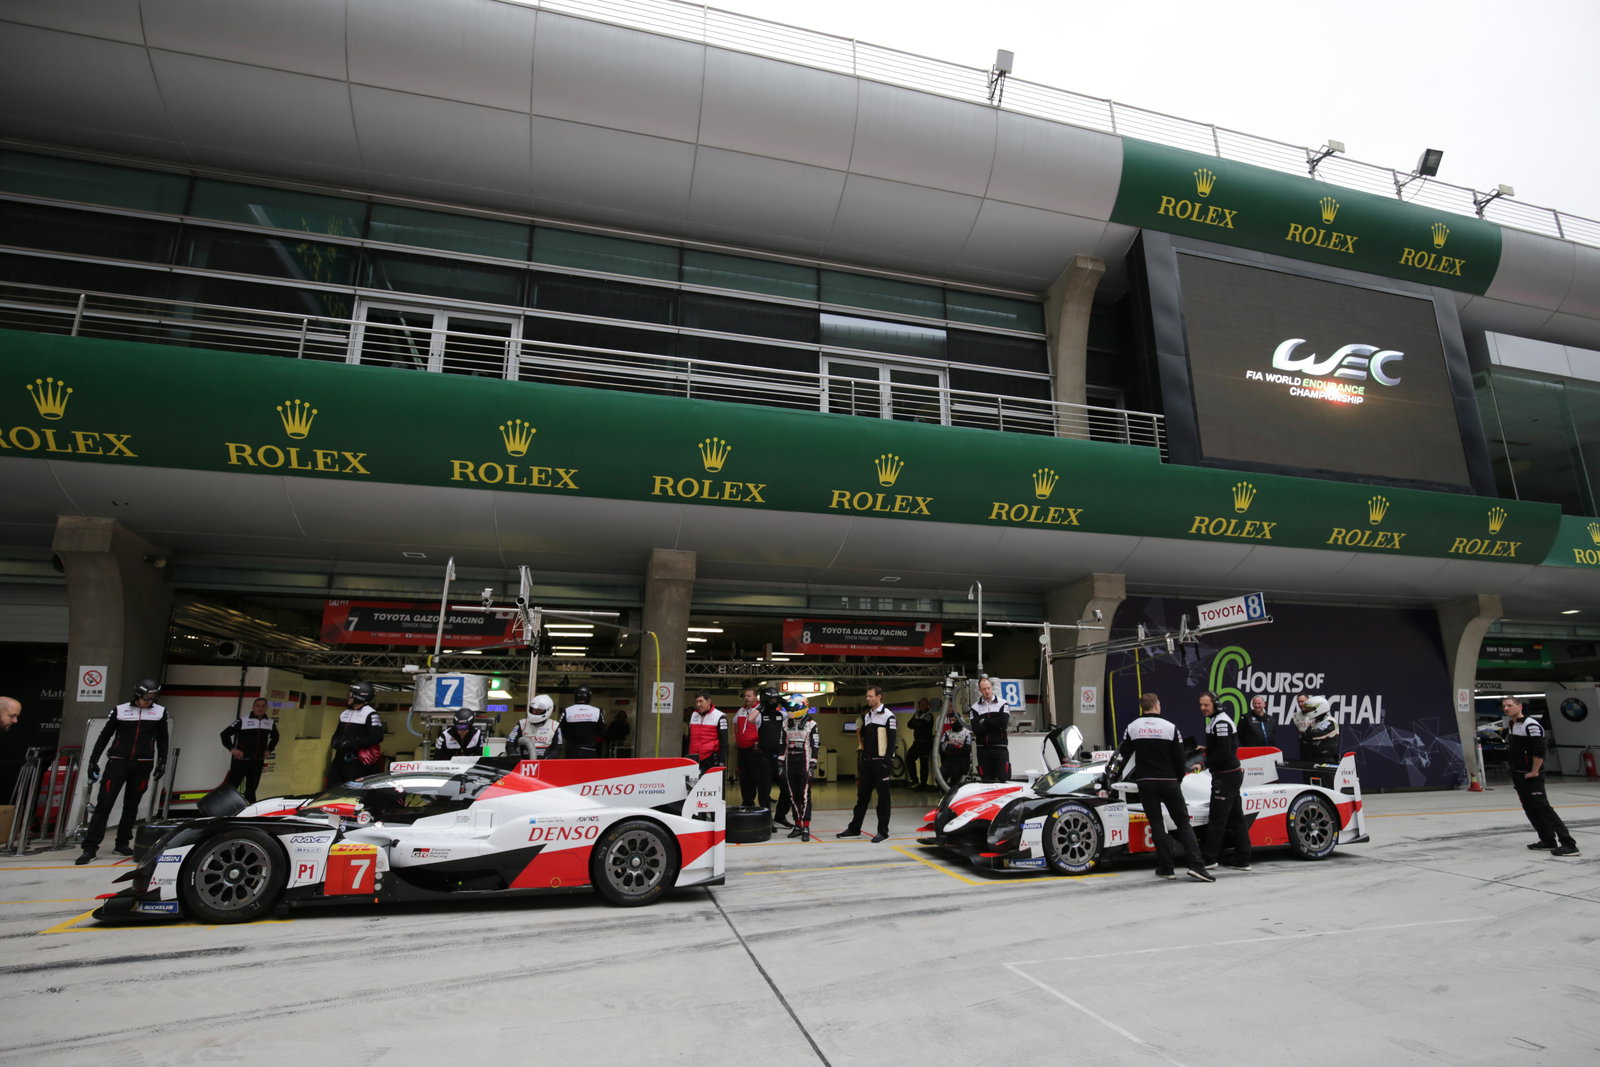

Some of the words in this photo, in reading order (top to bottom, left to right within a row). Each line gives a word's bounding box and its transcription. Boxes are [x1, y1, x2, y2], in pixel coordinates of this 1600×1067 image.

[1157, 195, 1238, 229] ROLEX
[1285, 223, 1359, 254] ROLEX
[1399, 248, 1466, 277] ROLEX
[1246, 370, 1264, 381] FIA
[1265, 372, 1301, 386] WORLD
[1302, 378, 1365, 395] ENDURANCE
[1289, 386, 1364, 405] CHAMPIONSHIP
[225, 442, 371, 475] ROLEX
[450, 460, 580, 490] ROLEX
[651, 475, 767, 503] ROLEX
[828, 490, 934, 515] ROLEX
[988, 502, 1083, 526] ROLEX
[1188, 516, 1277, 540] ROLEX
[1326, 527, 1407, 549] ROLEX
[1448, 537, 1522, 557] ROLEX
[373, 613, 410, 621] TOYOTA
[449, 616, 485, 624] RACING
[1201, 604, 1245, 621] TOYOTA
[1247, 595, 1261, 618] 8
[348, 617, 358, 632] 7
[802, 630, 812, 644] 8
[1236, 663, 1304, 693] HOURS
[1304, 672, 1325, 690] OF
[441, 679, 460, 705] 7
[1004, 683, 1019, 706] 8
[1250, 694, 1382, 726] HAGHAI
[521, 762, 538, 776] HY
[580, 783, 635, 796] DENSO
[1062, 806, 1088, 814] MICHELIN
[1246, 797, 1288, 810] DENSO
[528, 826, 599, 842] DENSO
[1112, 830, 1122, 840] P1
[1144, 824, 1155, 848] 8
[298, 864, 314, 879] P1
[350, 858, 370, 889] 7
